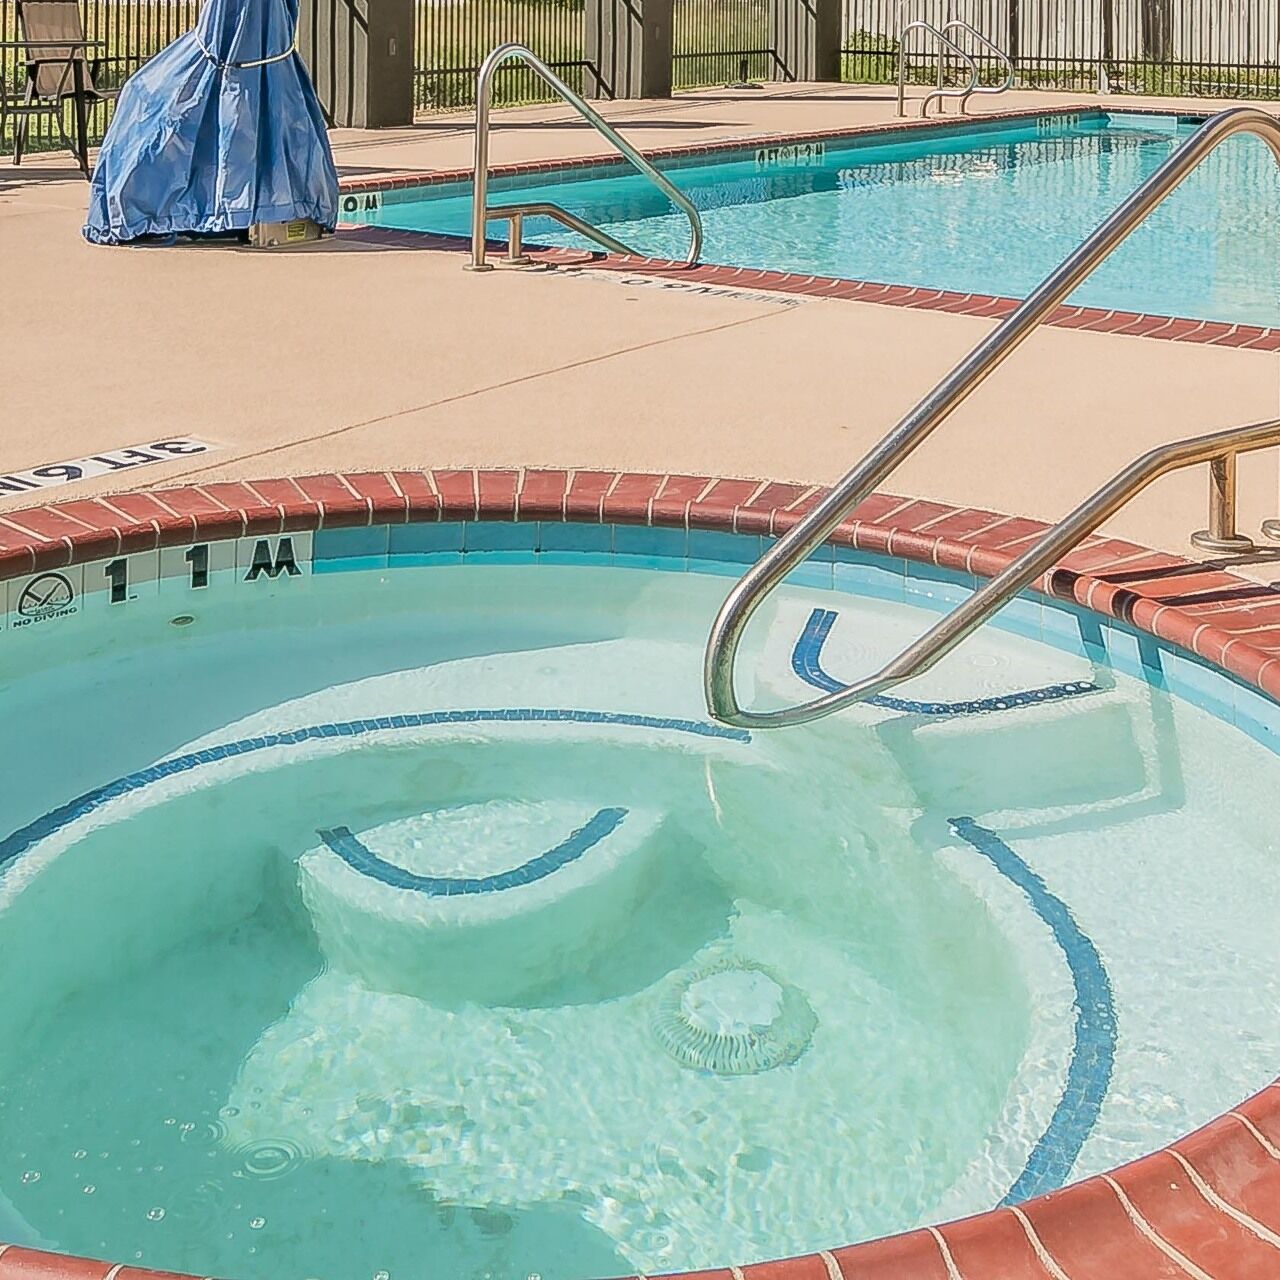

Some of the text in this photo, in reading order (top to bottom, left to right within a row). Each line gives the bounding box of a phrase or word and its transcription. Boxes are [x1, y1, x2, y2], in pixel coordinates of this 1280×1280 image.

[150, 440, 207, 455] 3
[82, 448, 166, 471] FT.
[32, 464, 83, 482] 6
[244, 537, 302, 582] M
[13, 618, 31, 628] NO
[34, 607, 77, 622] DIVING
